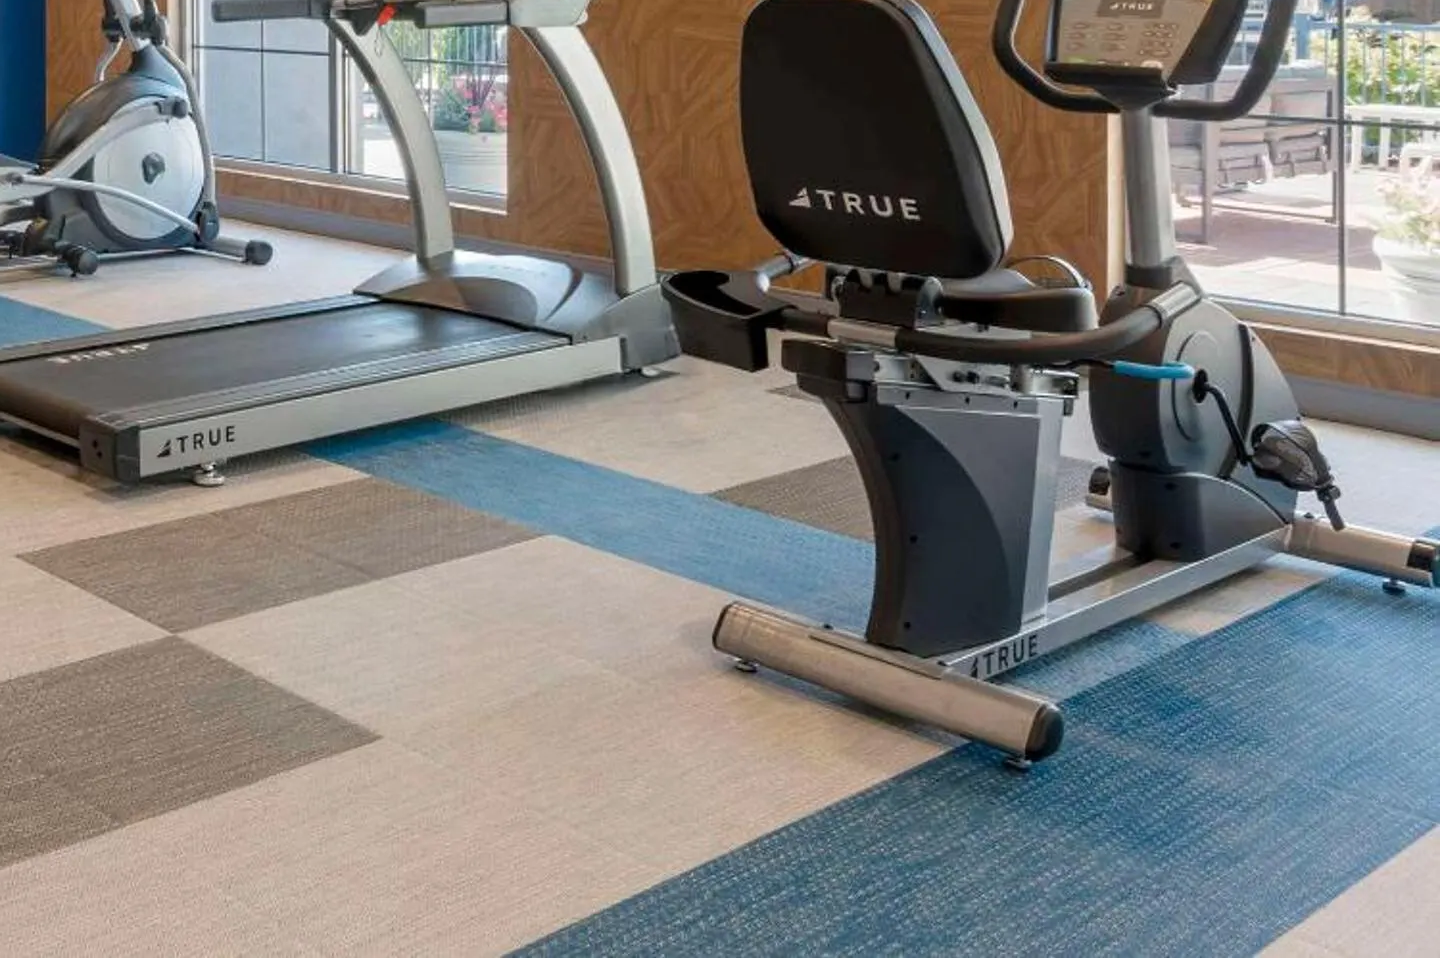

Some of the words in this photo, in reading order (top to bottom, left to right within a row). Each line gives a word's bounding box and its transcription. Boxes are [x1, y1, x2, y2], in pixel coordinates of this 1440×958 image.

[815, 189, 921, 220] TRUE
[176, 425, 236, 453] TRUE
[983, 634, 1039, 675] TRUE
